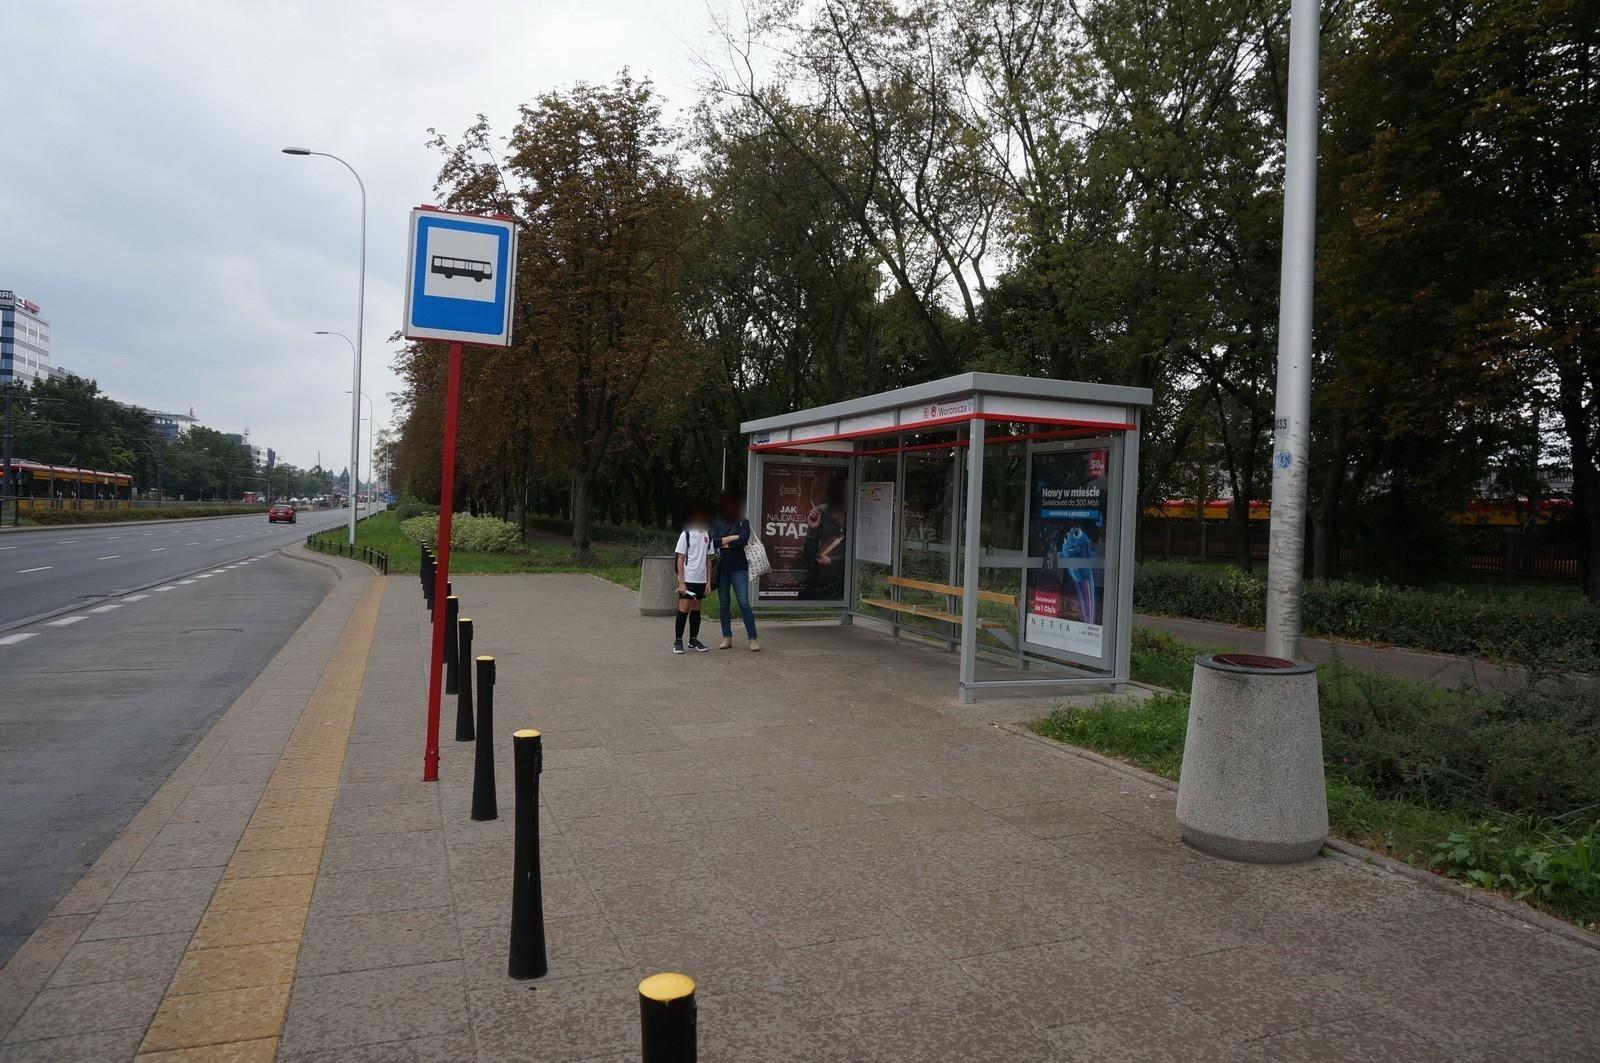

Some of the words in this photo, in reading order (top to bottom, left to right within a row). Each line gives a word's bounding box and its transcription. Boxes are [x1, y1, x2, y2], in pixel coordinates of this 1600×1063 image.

[938, 403, 967, 416] Woronicza
[1042, 488, 1062, 499] Nowy
[1063, 489, 1070, 497] w
[1071, 486, 1100, 497] mieście
[767, 513, 807, 521] NAJDALEJ
[765, 522, 808, 539] STĄD
